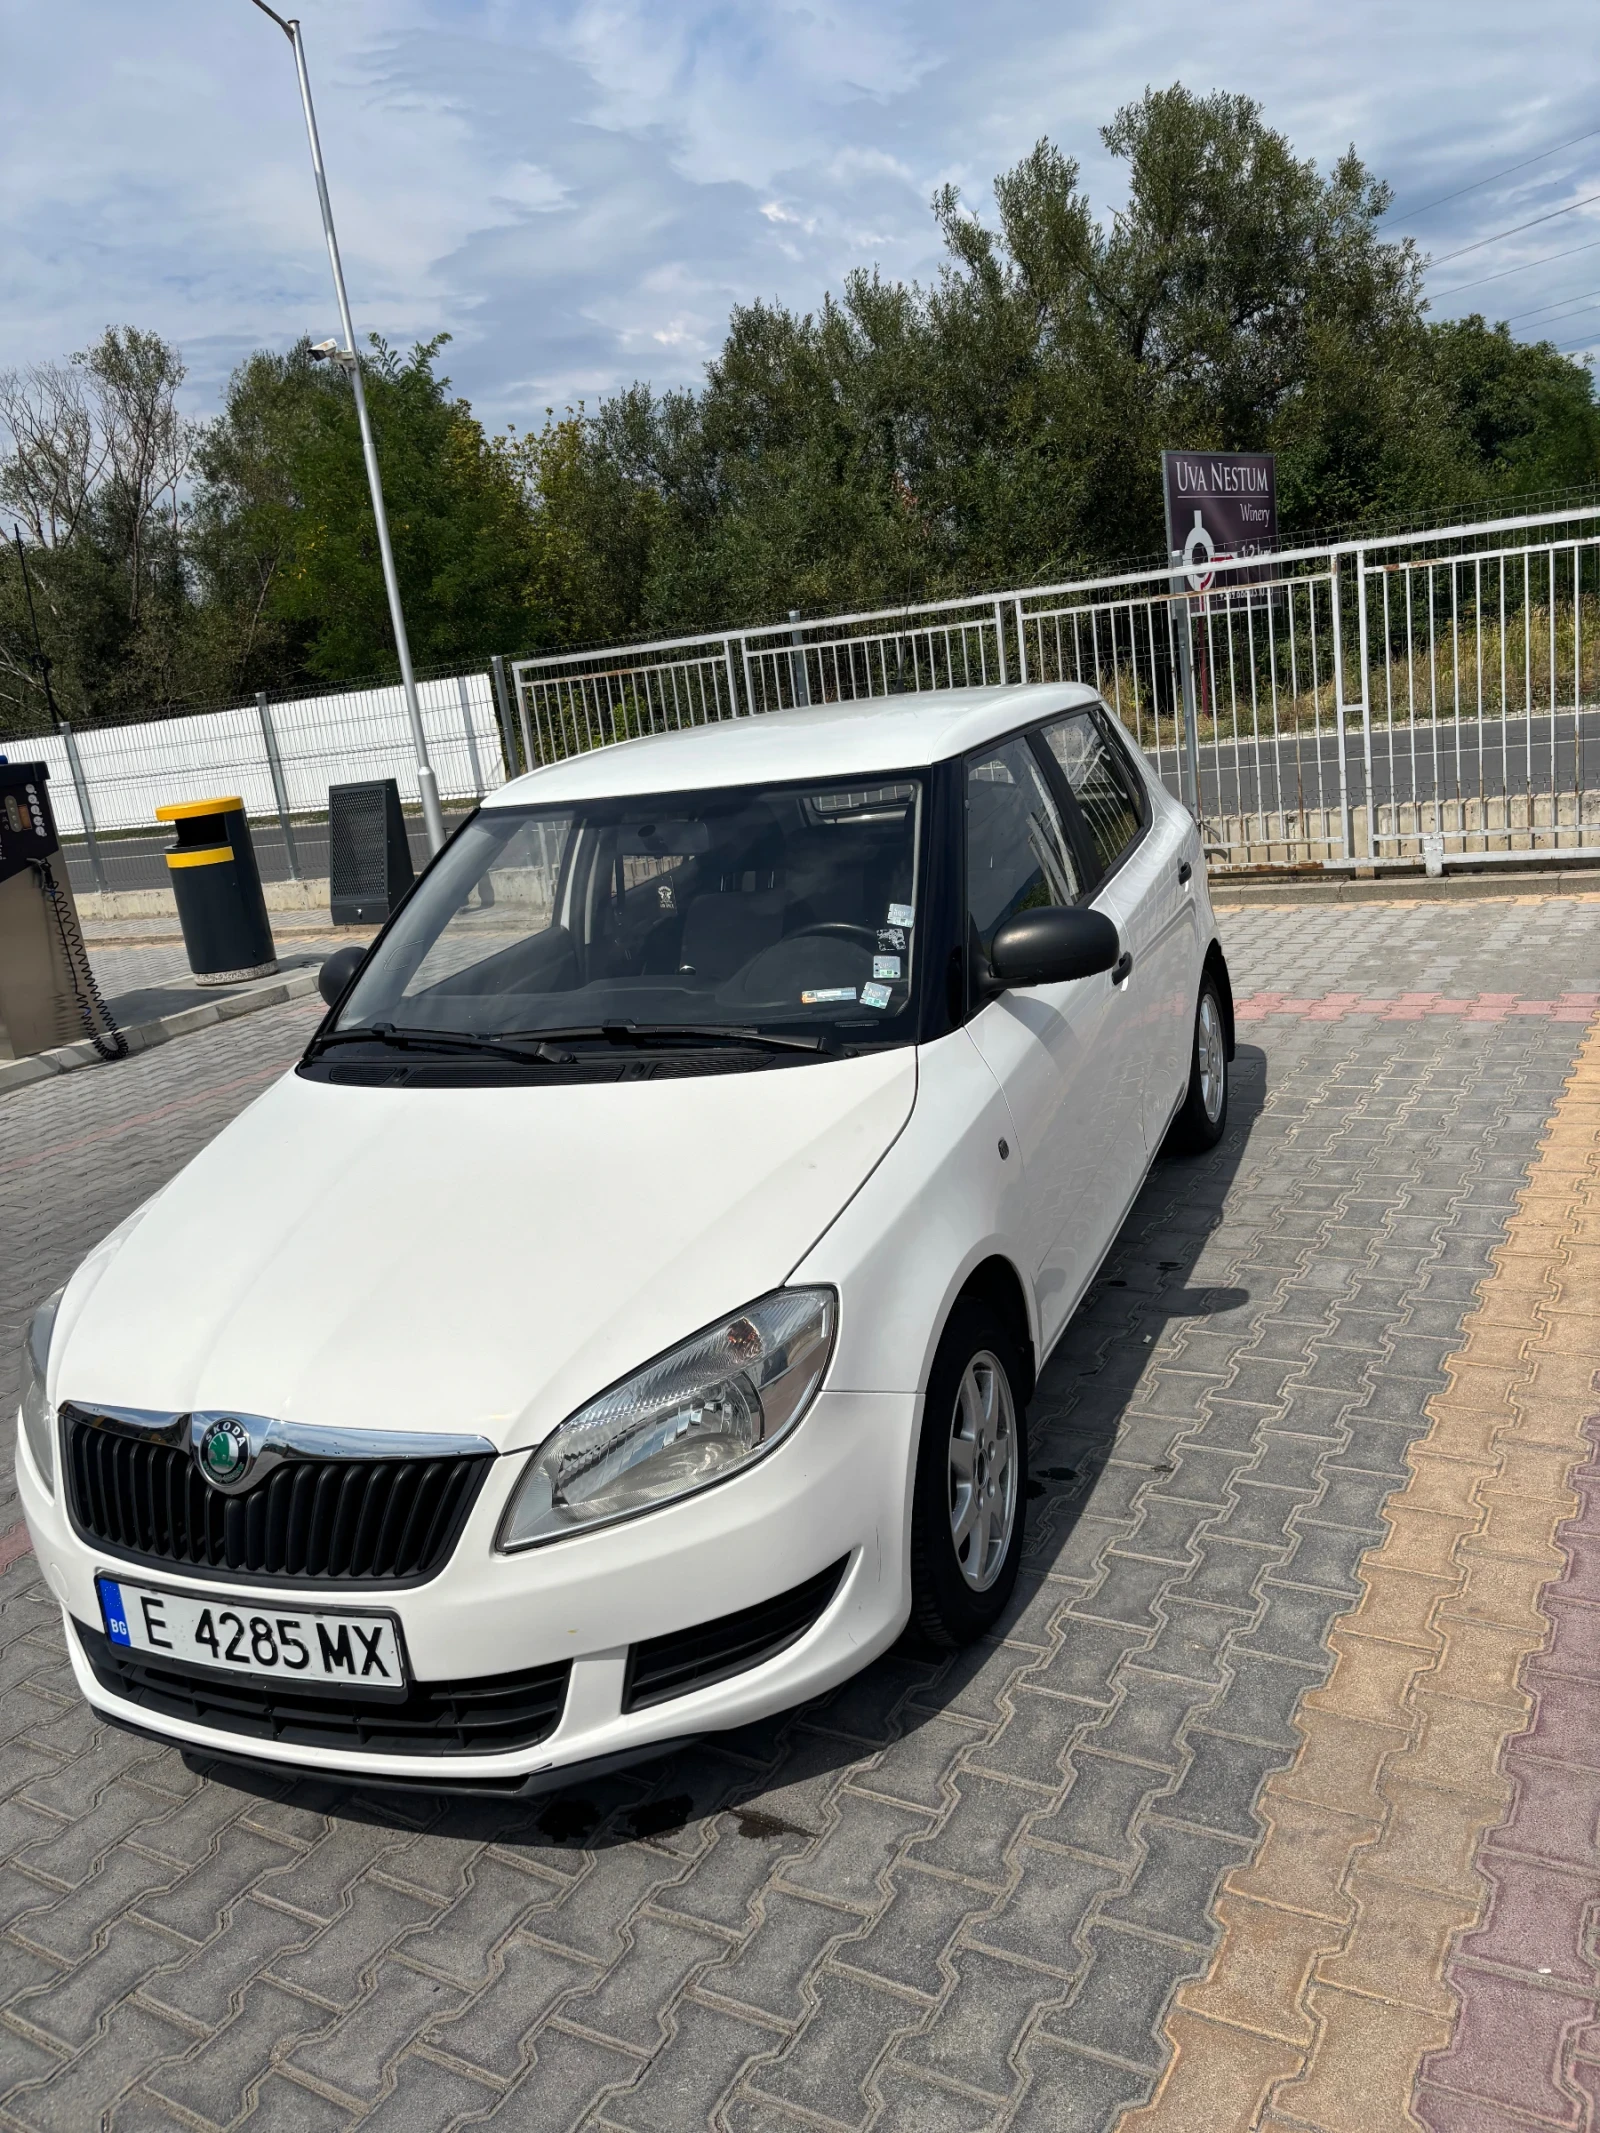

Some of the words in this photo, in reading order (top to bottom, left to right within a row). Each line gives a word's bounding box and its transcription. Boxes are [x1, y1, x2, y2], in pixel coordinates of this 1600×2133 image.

[1239, 503, 1270, 528] Winery
[110, 1618, 127, 1636] BG
[140, 1595, 174, 1649] E
[194, 1608, 310, 1670] 4285
[315, 1622, 392, 1678] MX
